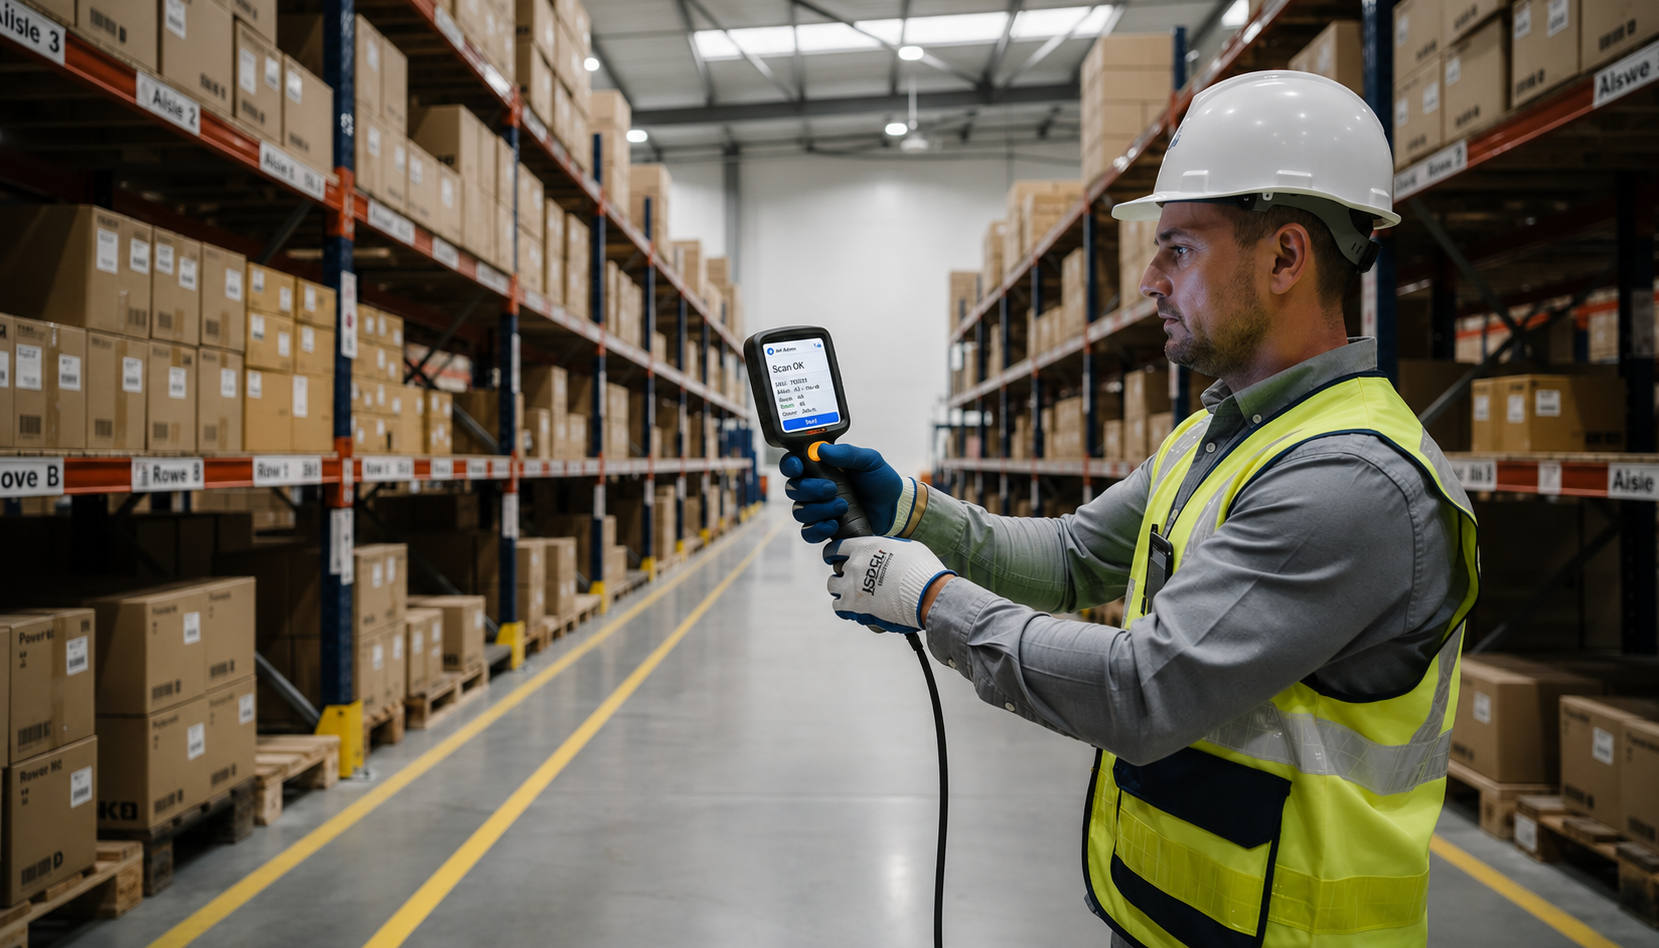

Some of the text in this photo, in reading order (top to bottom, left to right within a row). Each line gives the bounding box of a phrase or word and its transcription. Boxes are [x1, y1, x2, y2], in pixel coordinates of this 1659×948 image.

[49, 30, 60, 53] 3
[189, 106, 197, 127] 2
[772, 361, 805, 374] Scan OK
[47, 465, 60, 487] B
[153, 465, 187, 483] Rowe
[54, 851, 63, 869] D
